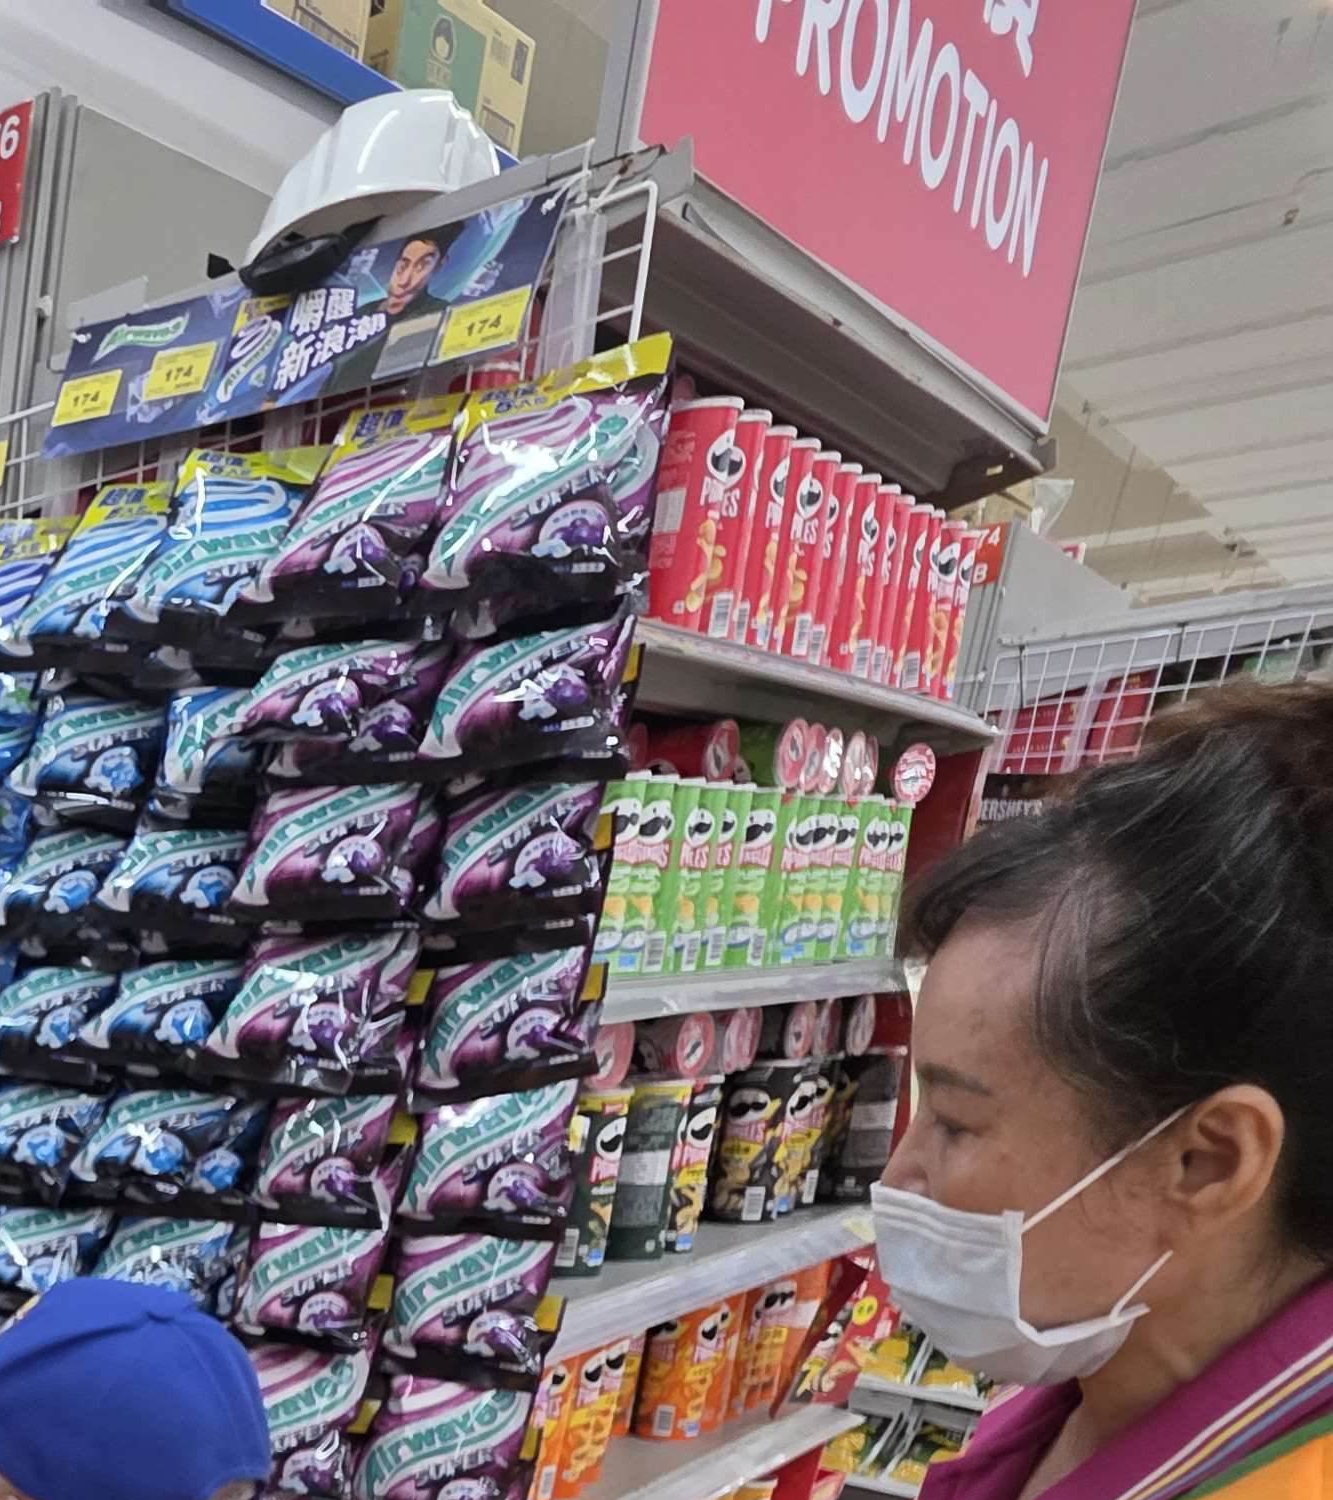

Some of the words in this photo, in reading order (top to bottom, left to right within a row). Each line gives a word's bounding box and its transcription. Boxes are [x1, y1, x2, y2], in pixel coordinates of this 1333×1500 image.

[464, 315, 503, 336] 174
[163, 364, 194, 381] 174
[72, 391, 101, 406] 174
[442, 1276, 522, 1324] SUPER
